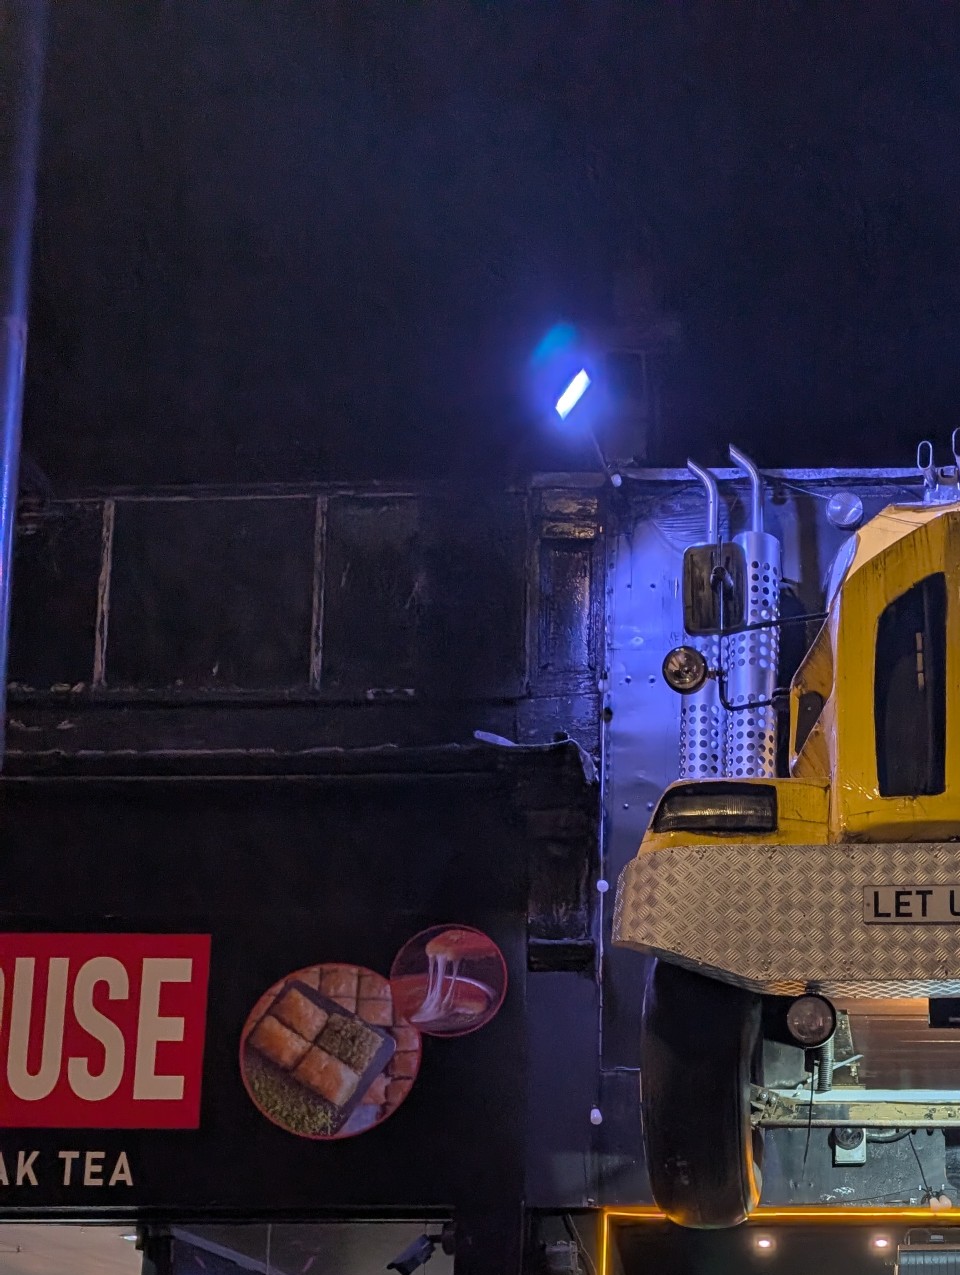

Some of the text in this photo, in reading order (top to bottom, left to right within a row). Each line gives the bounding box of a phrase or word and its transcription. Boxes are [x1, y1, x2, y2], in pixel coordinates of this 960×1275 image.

[873, 890, 933, 917] LET
[0, 957, 193, 1102] USE
[58, 1150, 134, 1187] TEA
